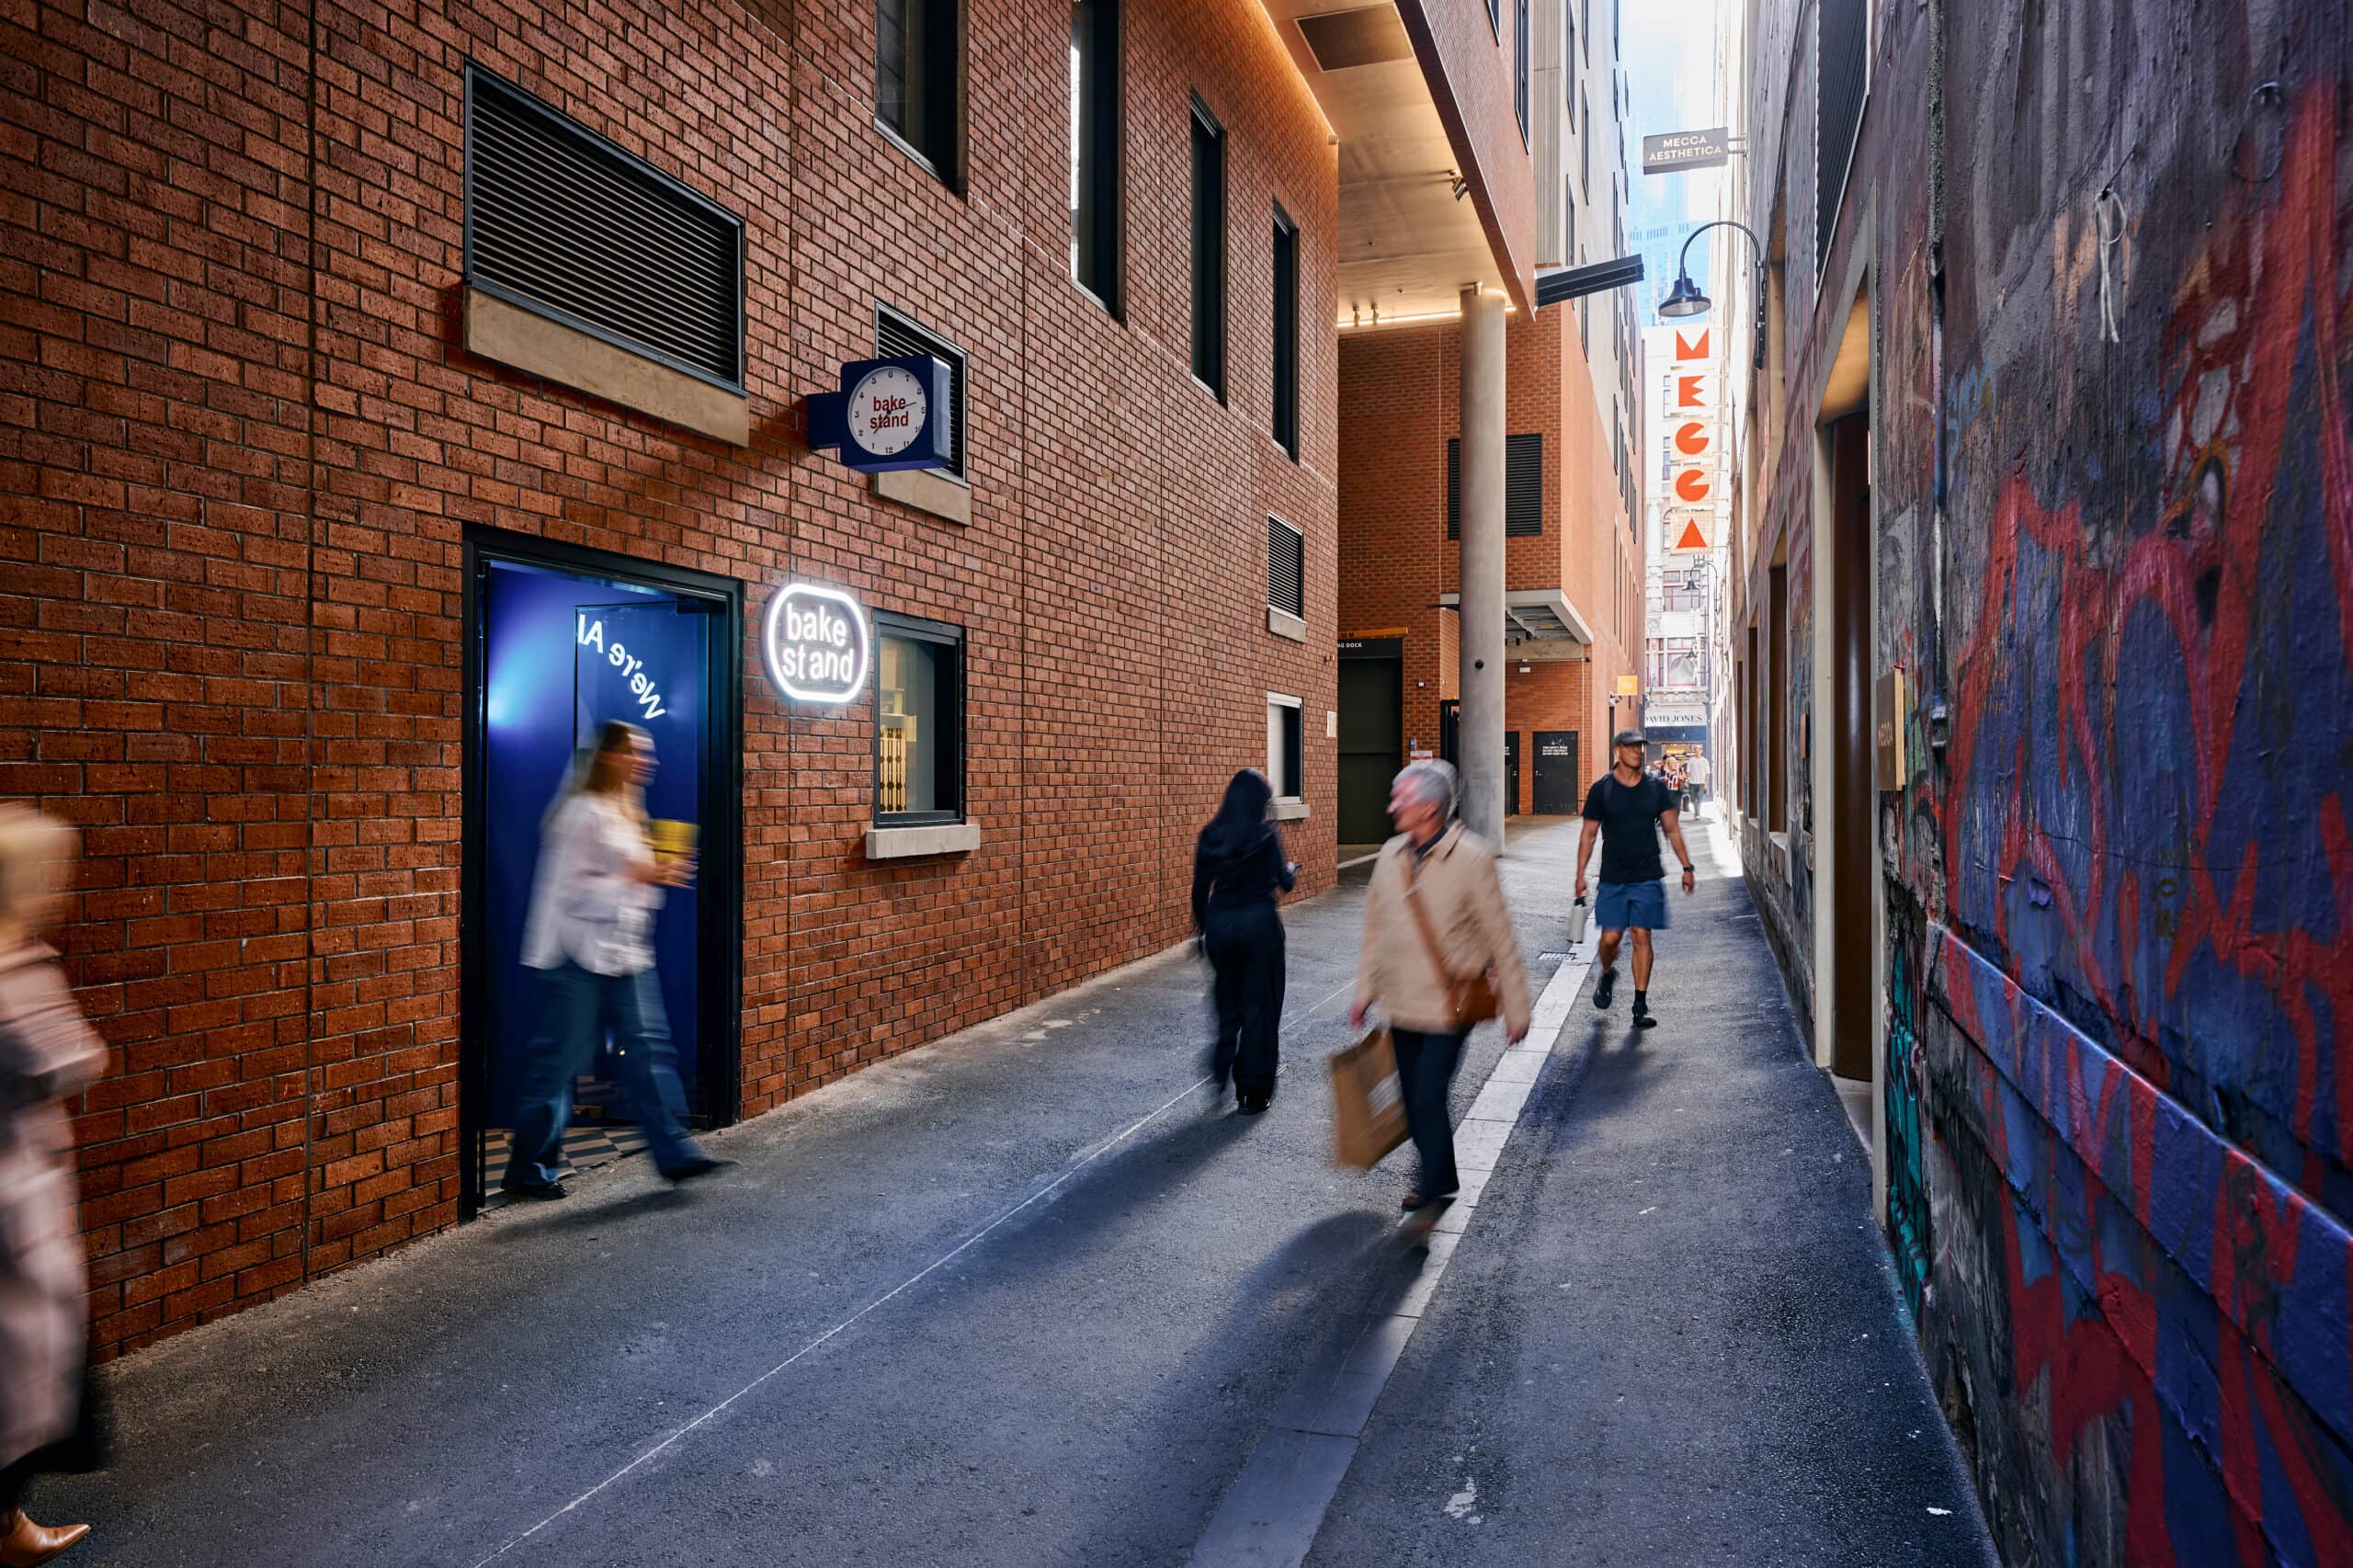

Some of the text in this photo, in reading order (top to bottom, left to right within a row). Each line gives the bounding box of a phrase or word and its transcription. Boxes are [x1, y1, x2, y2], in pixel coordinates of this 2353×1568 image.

[1663, 135, 1707, 148] MECCA
[1649, 144, 1722, 162] AESTHETICA
[888, 370, 893, 379] 6
[905, 374, 910, 382] 7
[873, 394, 906, 412] bake
[870, 411, 909, 429] stand
[787, 602, 847, 647] bake
[782, 644, 855, 683] stand
[1671, 715, 1703, 723] JONES
